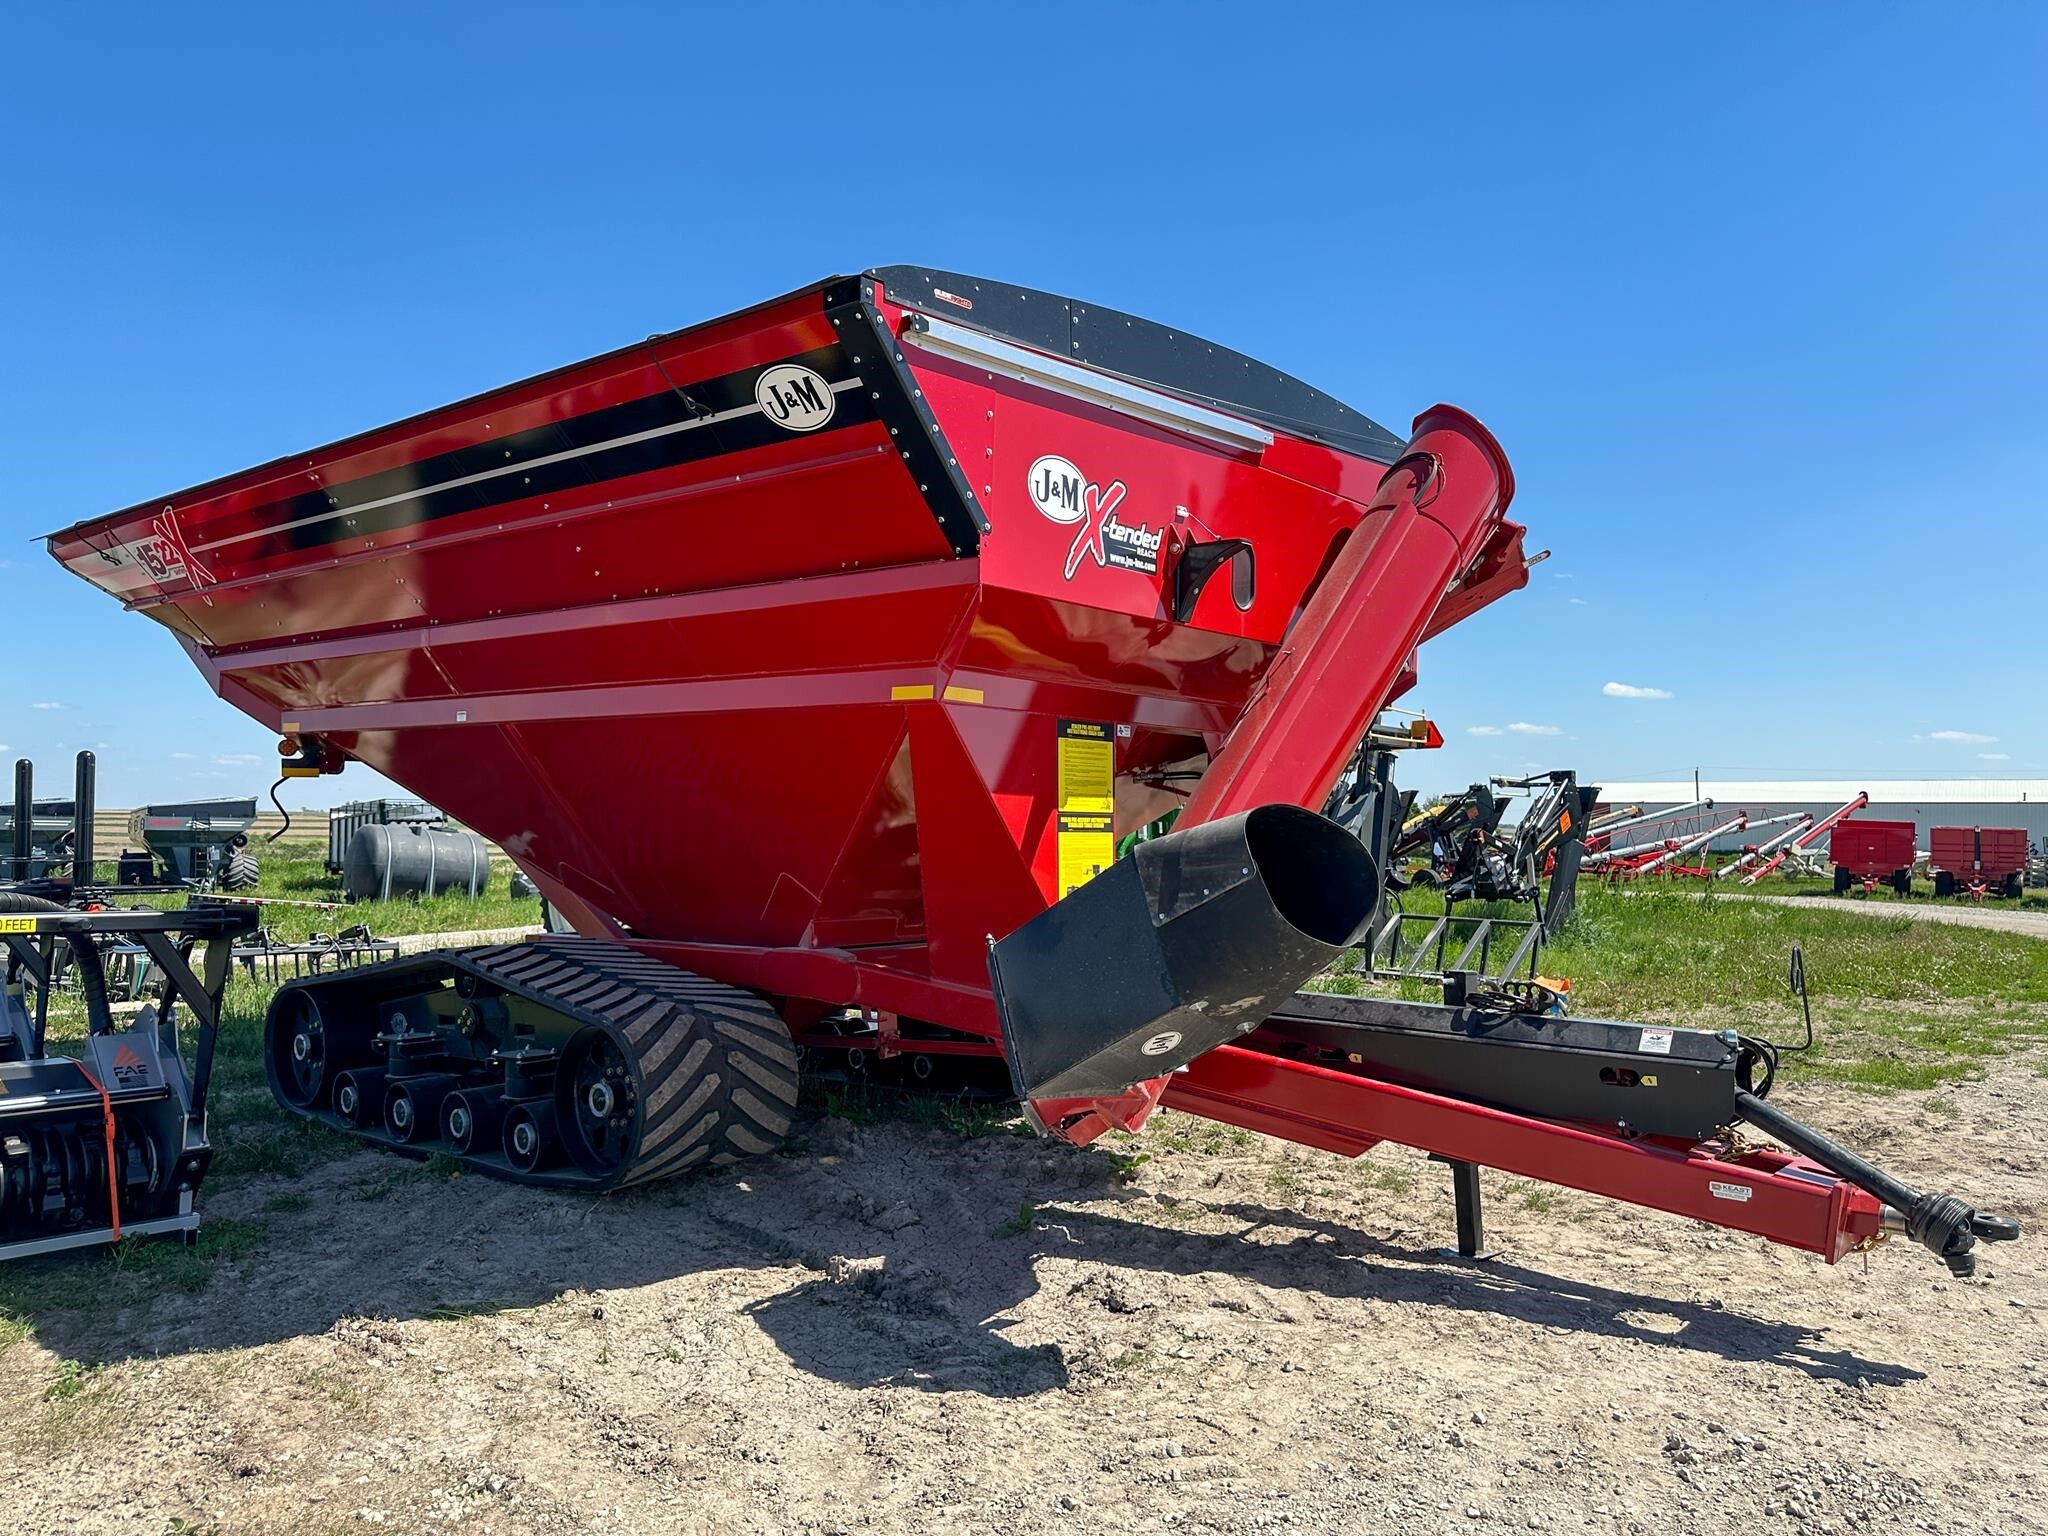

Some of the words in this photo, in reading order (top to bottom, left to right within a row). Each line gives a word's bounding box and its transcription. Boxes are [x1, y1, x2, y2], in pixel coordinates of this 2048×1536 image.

[766, 376, 828, 420] J&M
[1035, 468, 1080, 513] J&M
[1136, 547, 1157, 560] REACH
[5, 918, 35, 931] FEET
[113, 1064, 149, 1077] FAE
[1722, 1185, 1750, 1193] KEAST
